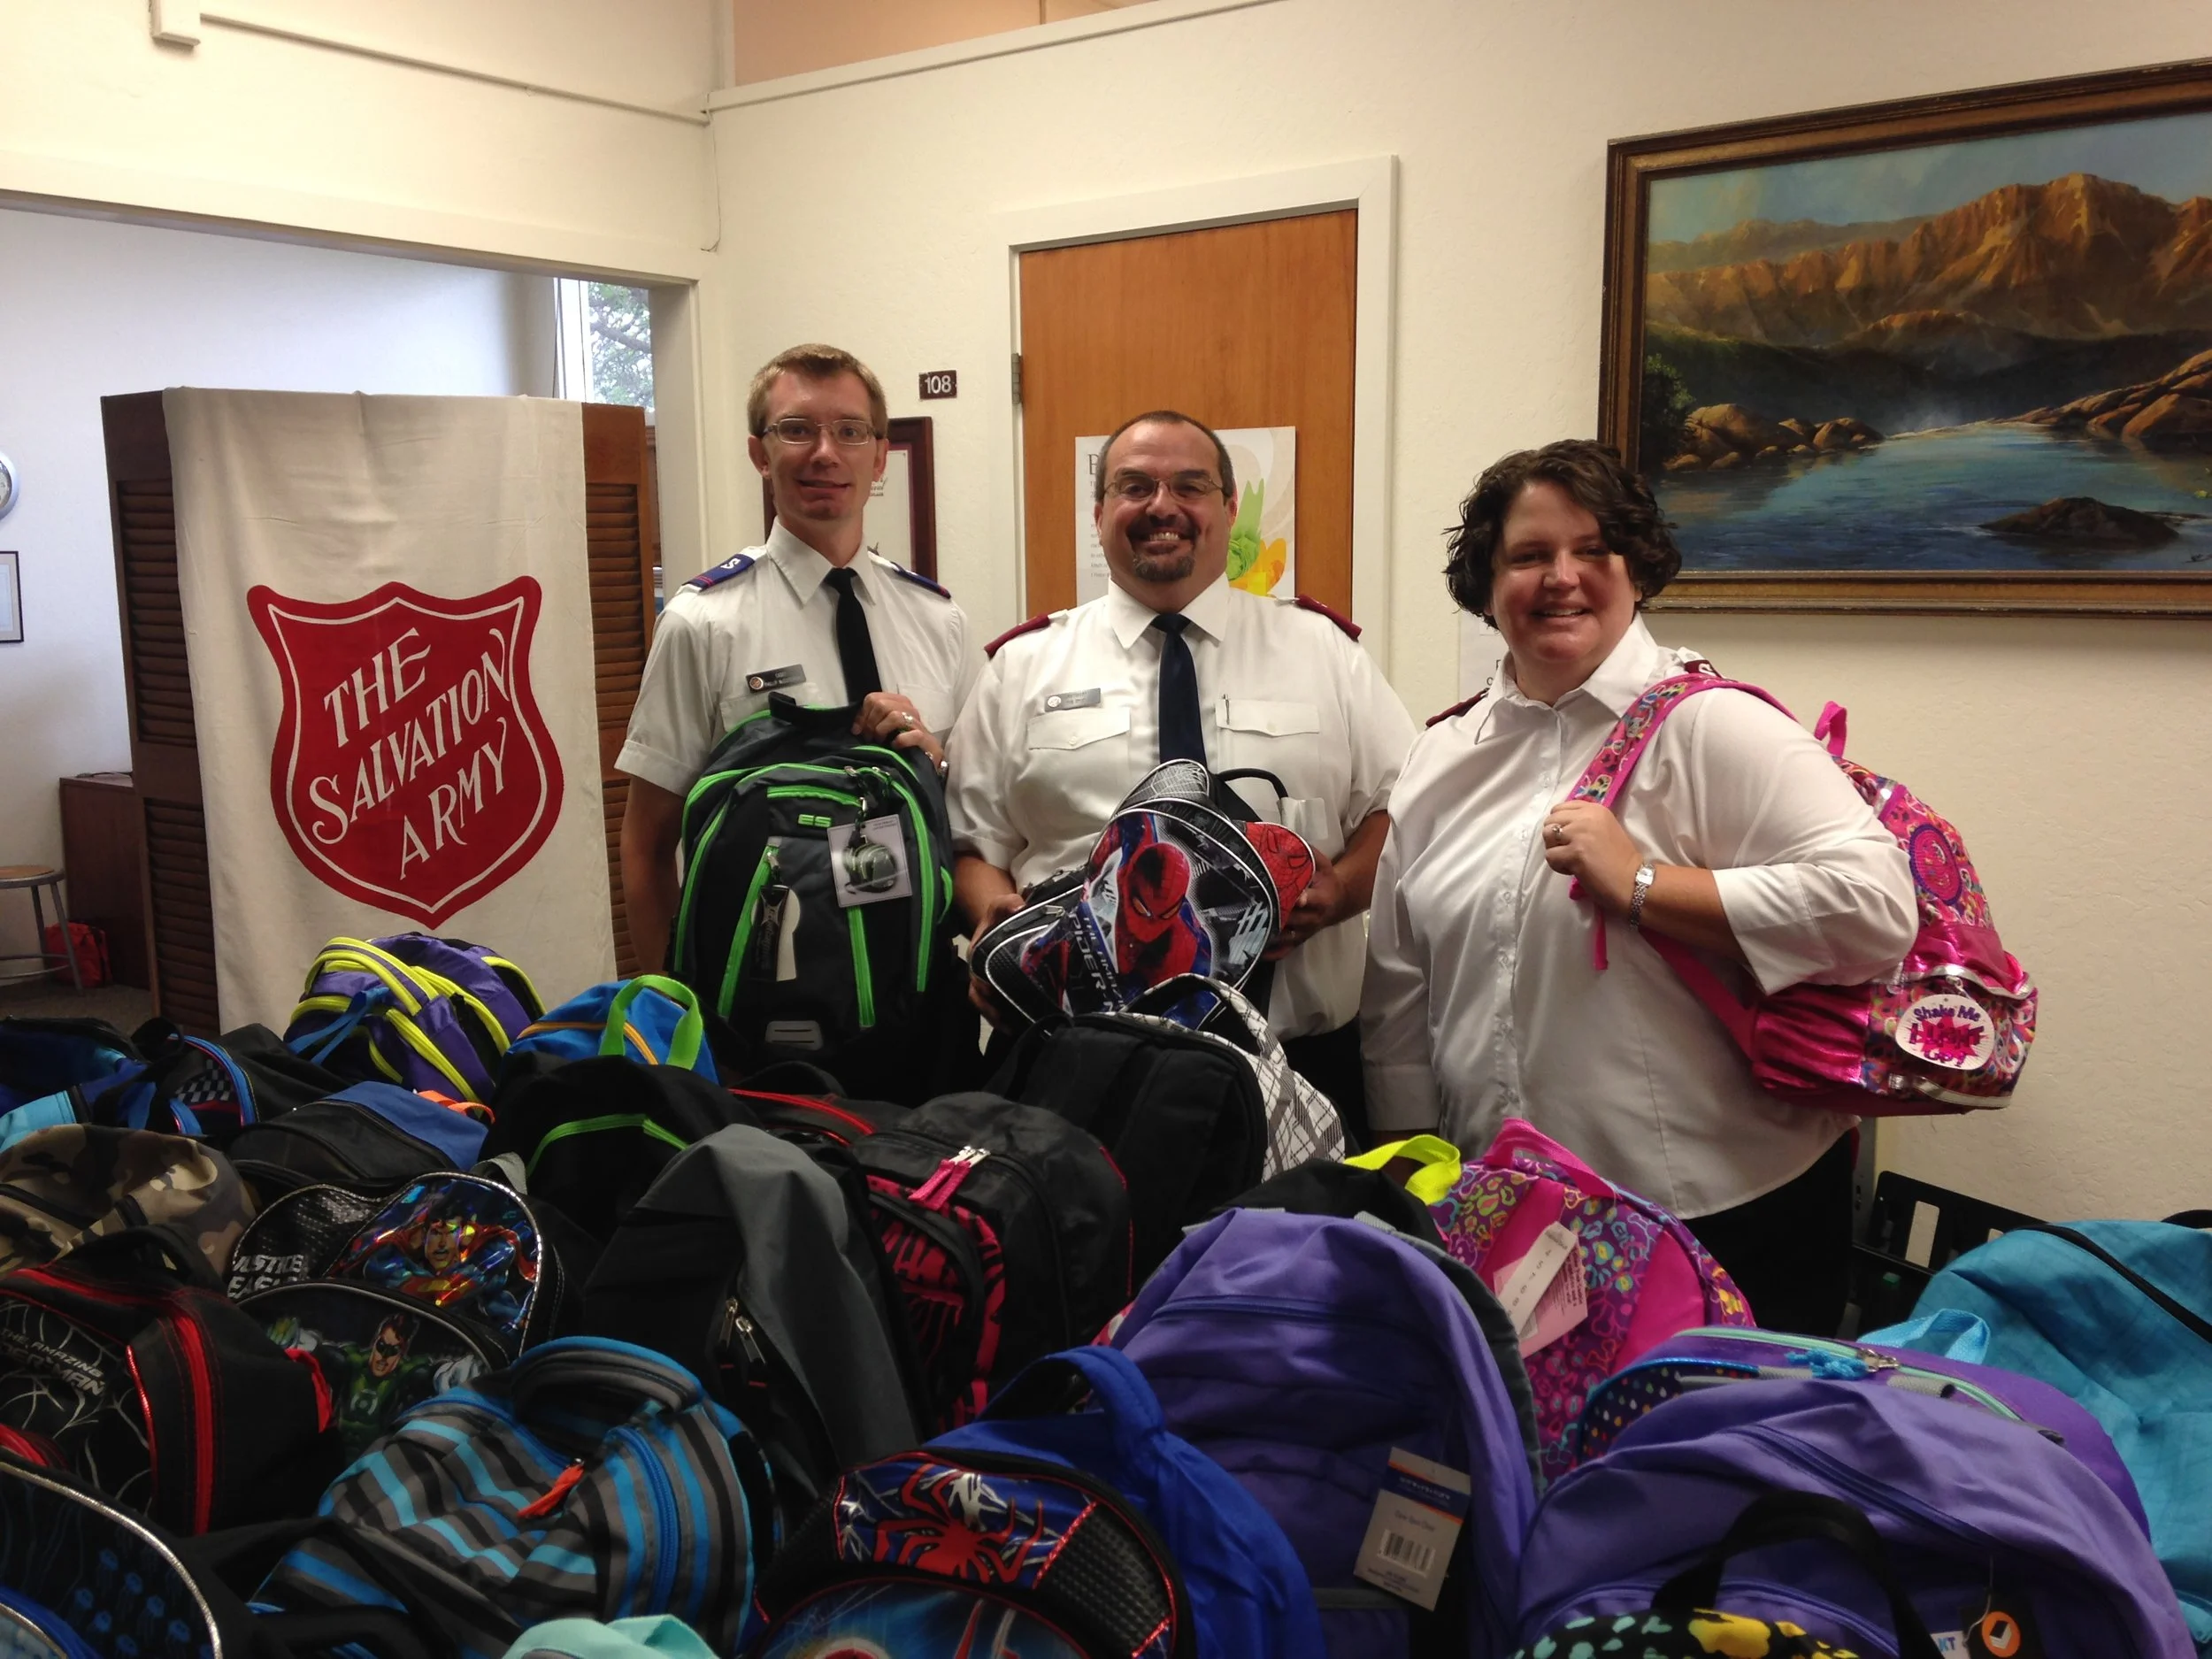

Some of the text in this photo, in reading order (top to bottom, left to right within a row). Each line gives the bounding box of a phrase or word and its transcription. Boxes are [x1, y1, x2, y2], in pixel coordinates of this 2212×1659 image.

[925, 375, 951, 394] 108
[323, 626, 432, 749] THE
[309, 628, 510, 844] SALVATION
[399, 717, 508, 880] ARMY
[798, 814, 832, 828] ES
[1913, 1004, 1981, 1022] Shake Me
[31, 1341, 104, 1378] AMAZING
